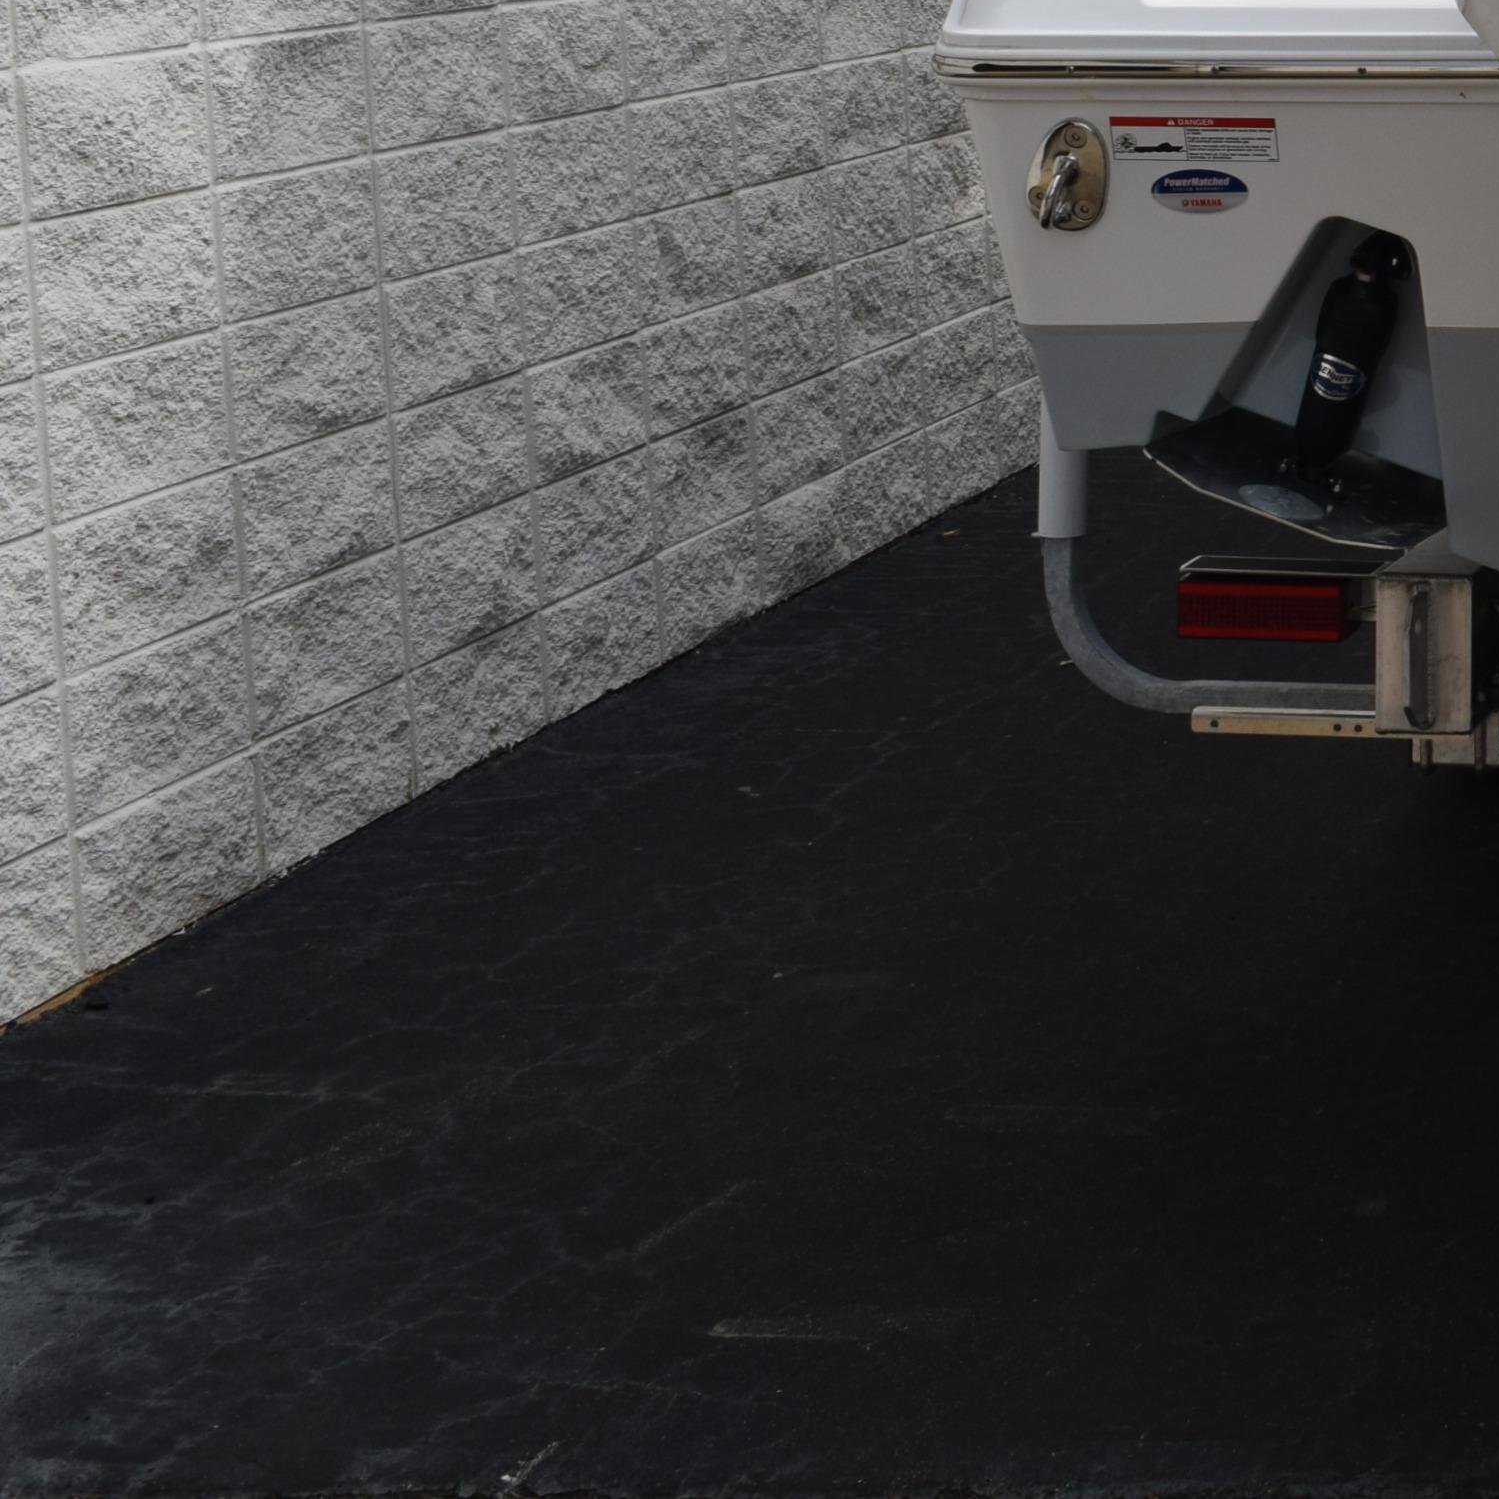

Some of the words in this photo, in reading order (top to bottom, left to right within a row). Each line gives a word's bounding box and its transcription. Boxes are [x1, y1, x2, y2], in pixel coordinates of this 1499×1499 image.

[1177, 118, 1215, 126] DANGER
[1163, 177, 1232, 187] PowerMatched
[1191, 198, 1223, 207] YAMAHA
[1318, 365, 1353, 382] ENNETT
